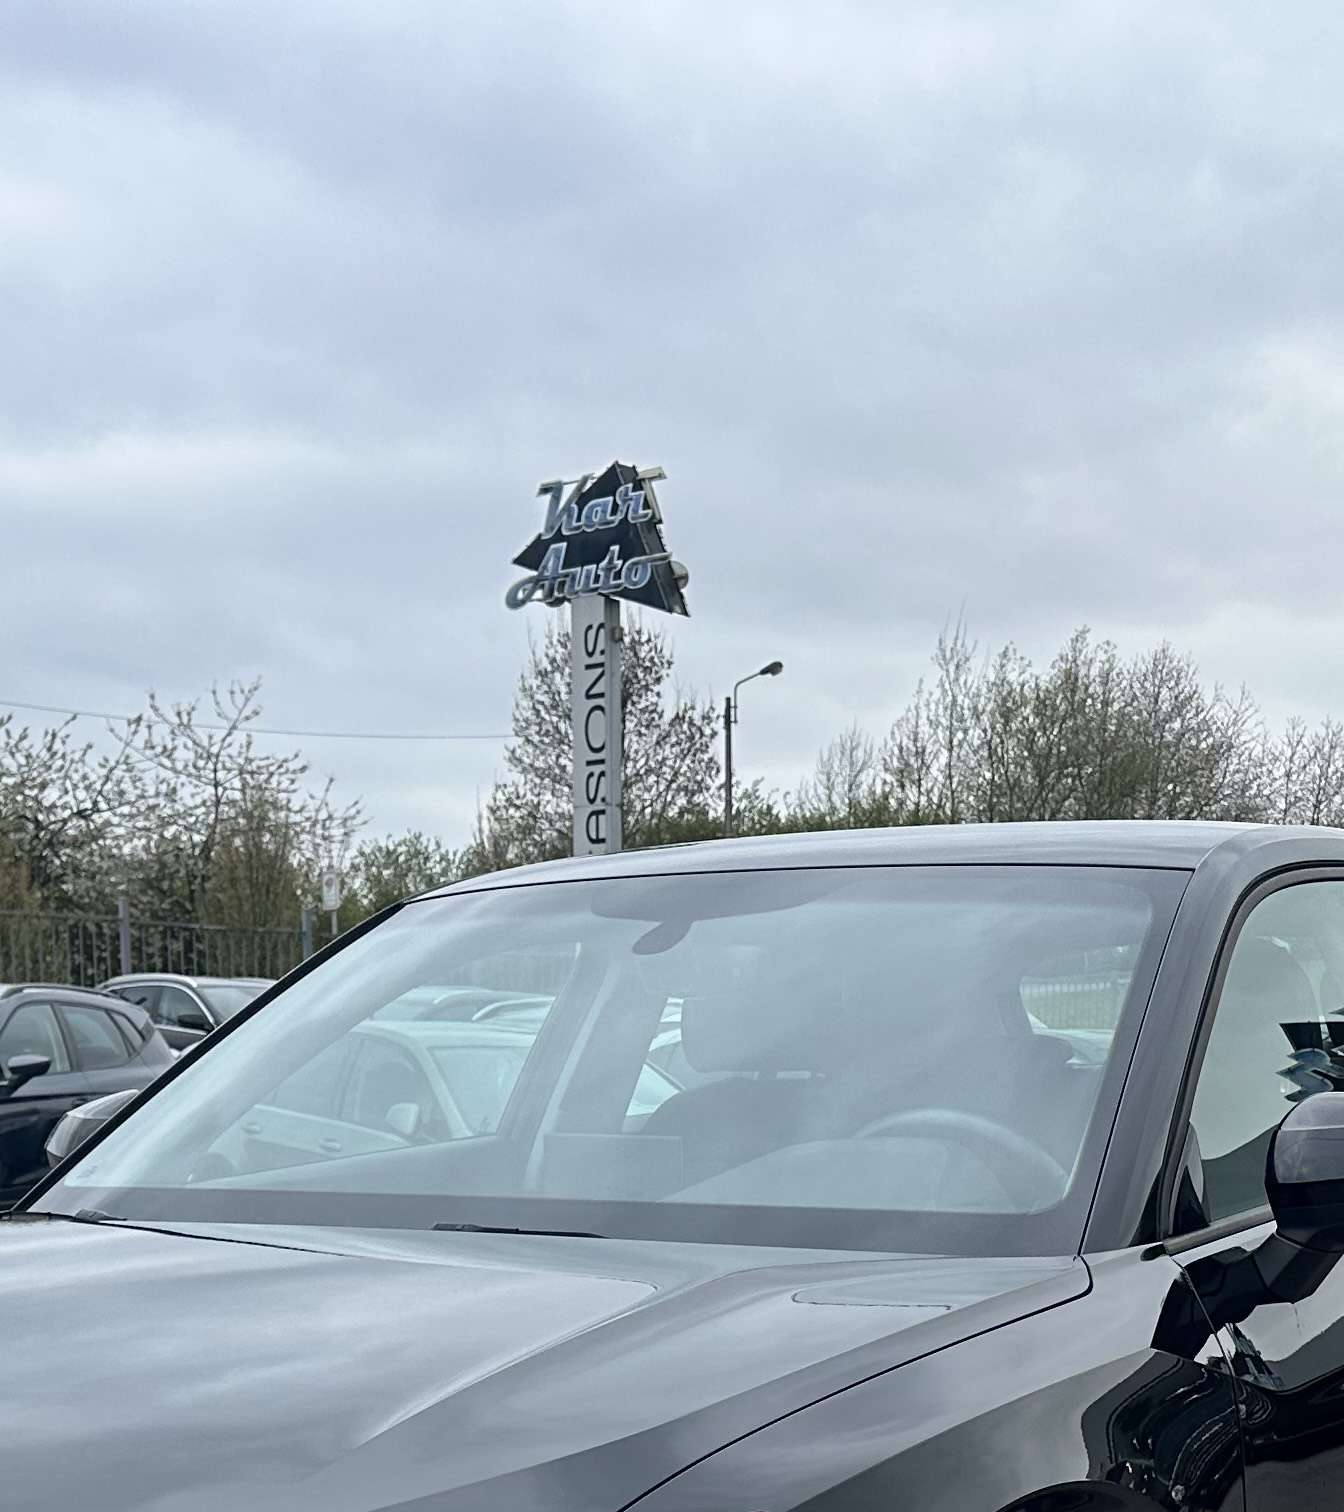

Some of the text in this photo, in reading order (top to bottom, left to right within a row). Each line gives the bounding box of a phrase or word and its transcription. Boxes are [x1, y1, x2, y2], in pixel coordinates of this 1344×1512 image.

[537, 473, 654, 541] Kar
[505, 541, 674, 610] Auto
[583, 621, 609, 853] ASIONS
